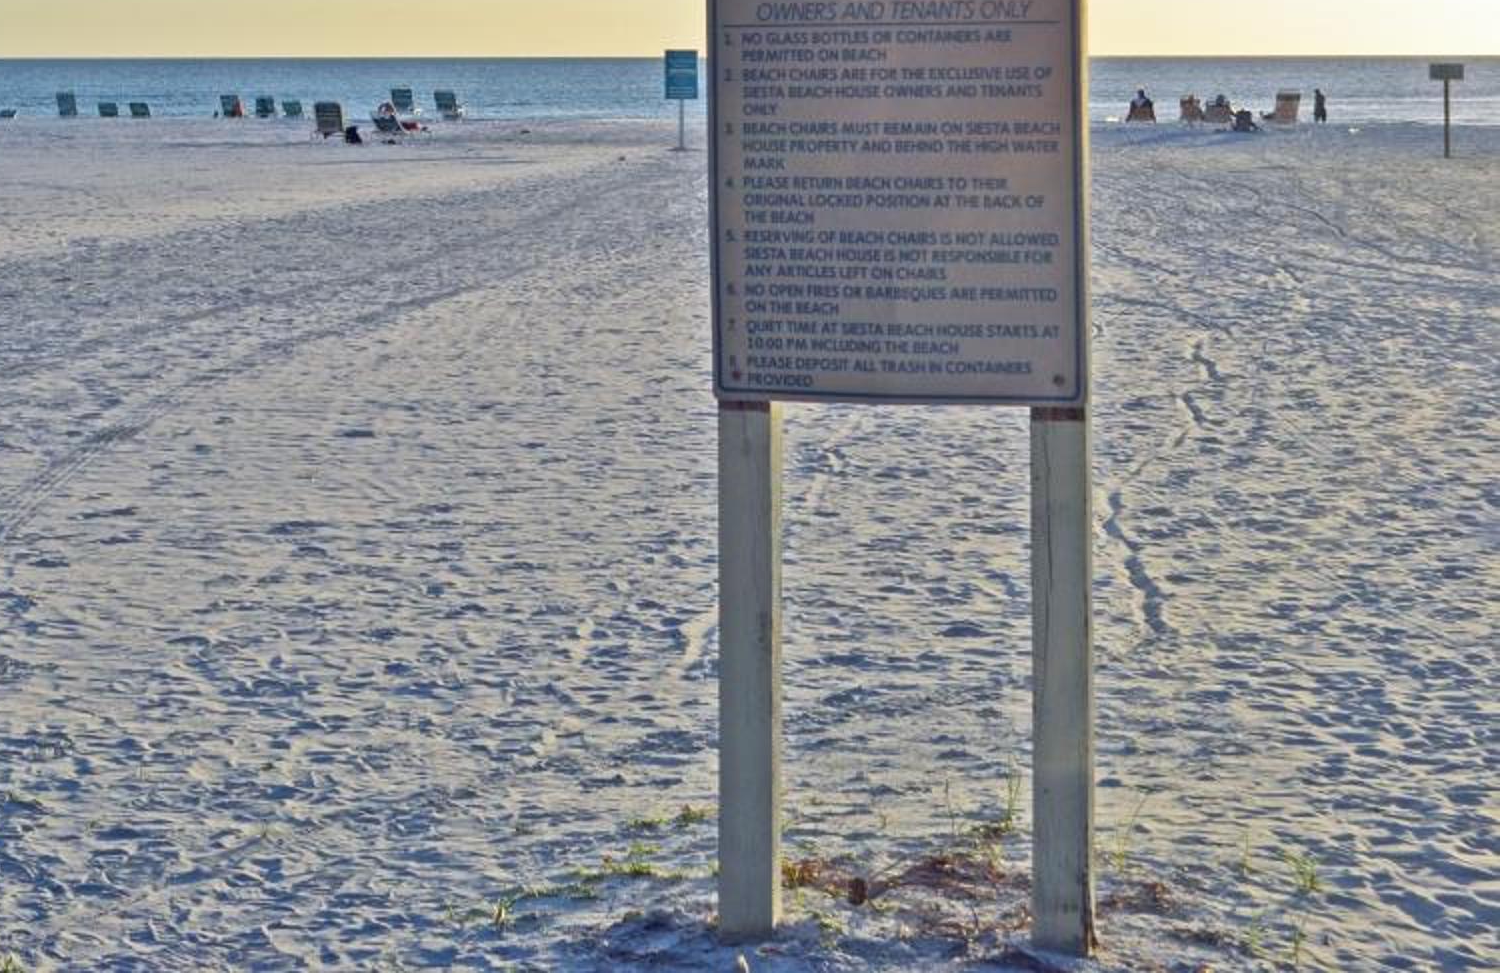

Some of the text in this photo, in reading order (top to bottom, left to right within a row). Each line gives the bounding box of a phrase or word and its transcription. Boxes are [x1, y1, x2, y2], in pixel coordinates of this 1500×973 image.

[756, 0, 1032, 21] OWNERS AND TENANTS ONLY
[742, 33, 762, 45] NO
[766, 32, 807, 45] GLASS
[812, 31, 868, 44] BOTTLES
[873, 31, 891, 44] OR
[896, 30, 980, 44] CONTAINERS
[985, 30, 1012, 42] ARE
[742, 49, 886, 62] PERMITTED ON BEACH
[742, 69, 786, 81] BEACH
[789, 69, 837, 81] CHAIRS
[841, 69, 867, 81] ARE
[870, 68, 896, 81] FOR
[901, 68, 925, 80] THE
[929, 67, 1002, 80] EXCLUSIVE
[1005, 67, 1029, 80] USE
[1034, 67, 1052, 79] OF
[743, 85, 1042, 99] SIESTA BEACH HOUSE OWNERS AND TENANTS
[743, 104, 777, 116] ONLY
[743, 123, 786, 135] BEACH
[790, 123, 837, 135] CHAIRS
[842, 123, 880, 135] MUST
[884, 123, 937, 135] REMAIN
[941, 123, 962, 135] ON
[966, 123, 1010, 135] SIESTA
[1014, 123, 1060, 135] BEACH
[743, 141, 786, 153] HOUSE
[790, 141, 857, 153] PROPERTY
[862, 141, 892, 153] AND
[948, 141, 971, 153] THE
[1012, 141, 1058, 153] WATER
[744, 158, 785, 171] MARK
[743, 178, 788, 190] PLEASE
[793, 178, 842, 190] RETURN
[846, 178, 890, 190] BEACH
[894, 178, 943, 190] CHAIRS
[948, 178, 966, 190] TO
[743, 195, 1044, 208] ORIGINAL LOCKED POSITION AT THE BACK OF
[744, 212, 813, 224] THE BEACH
[818, 231, 836, 243] OF
[840, 231, 883, 244] BEACH
[887, 232, 936, 245] CHAIRS
[940, 233, 952, 245] IS
[956, 233, 984, 245] NOT
[990, 233, 1058, 246] ALLOWED
[744, 248, 785, 260] SIESTA
[790, 249, 832, 261] BEACH
[837, 250, 880, 262] HOUSE
[884, 250, 895, 262] IS
[900, 250, 927, 263] NOT
[1024, 250, 1052, 263] FOR
[745, 265, 946, 280] ANY ARTICLES LEFT ON CHAIRS
[745, 284, 764, 297] NO
[769, 284, 803, 297] OPEN
[807, 285, 839, 298] FIRES
[843, 286, 861, 298] OR
[950, 289, 976, 301] ARE
[981, 289, 1057, 302] PERMITTED
[745, 301, 839, 315] ON THE BEACH
[821, 322, 837, 334] AT
[842, 323, 883, 335] SIESTA
[888, 325, 932, 336] BEACH
[937, 325, 982, 337] HOUSE
[987, 325, 1037, 338] STARTS
[1042, 326, 1059, 338] AT
[812, 338, 880, 352] INCLUDING
[885, 341, 908, 353] THE
[914, 341, 958, 353] BEACH
[747, 356, 793, 368] PLEASE
[796, 357, 848, 370] DEPOSIT
[853, 359, 875, 371] ALL
[880, 360, 925, 373] TRASH
[930, 361, 942, 373] IN
[946, 361, 1031, 374] CONTAINERS
